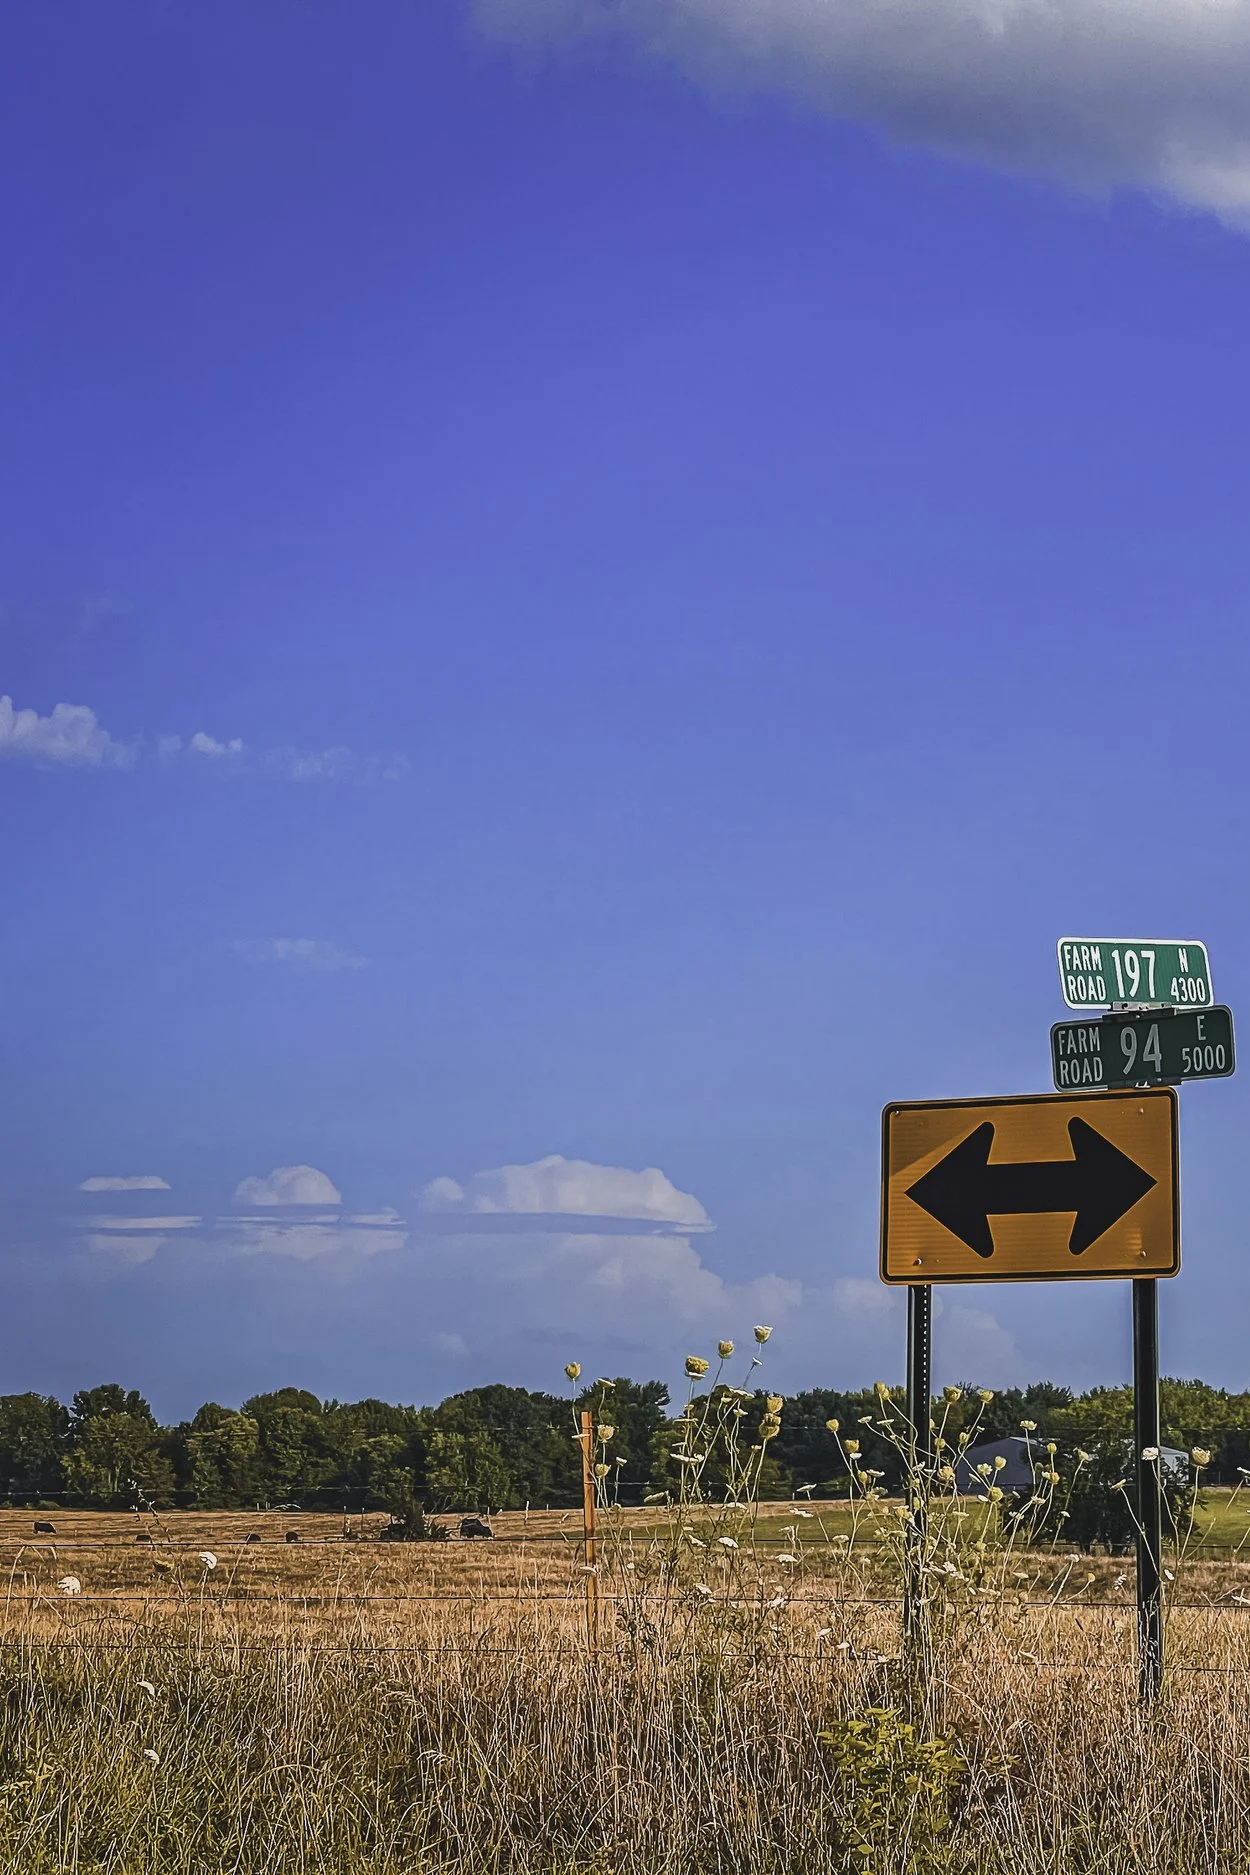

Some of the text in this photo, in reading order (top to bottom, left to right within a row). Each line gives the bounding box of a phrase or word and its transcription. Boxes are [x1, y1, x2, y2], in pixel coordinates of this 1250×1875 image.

[1063, 945, 1103, 971] FARM
[1178, 948, 1189, 973] N
[1111, 949, 1156, 999] 197
[1067, 975, 1106, 1001] ROAD
[1170, 977, 1206, 1002] 4300
[1058, 1027, 1101, 1055] FARM
[1196, 1015, 1206, 1041] E
[1120, 1023, 1162, 1075] 94
[1181, 1044, 1226, 1073] 5000
[1059, 1057, 1103, 1085] ROAD
